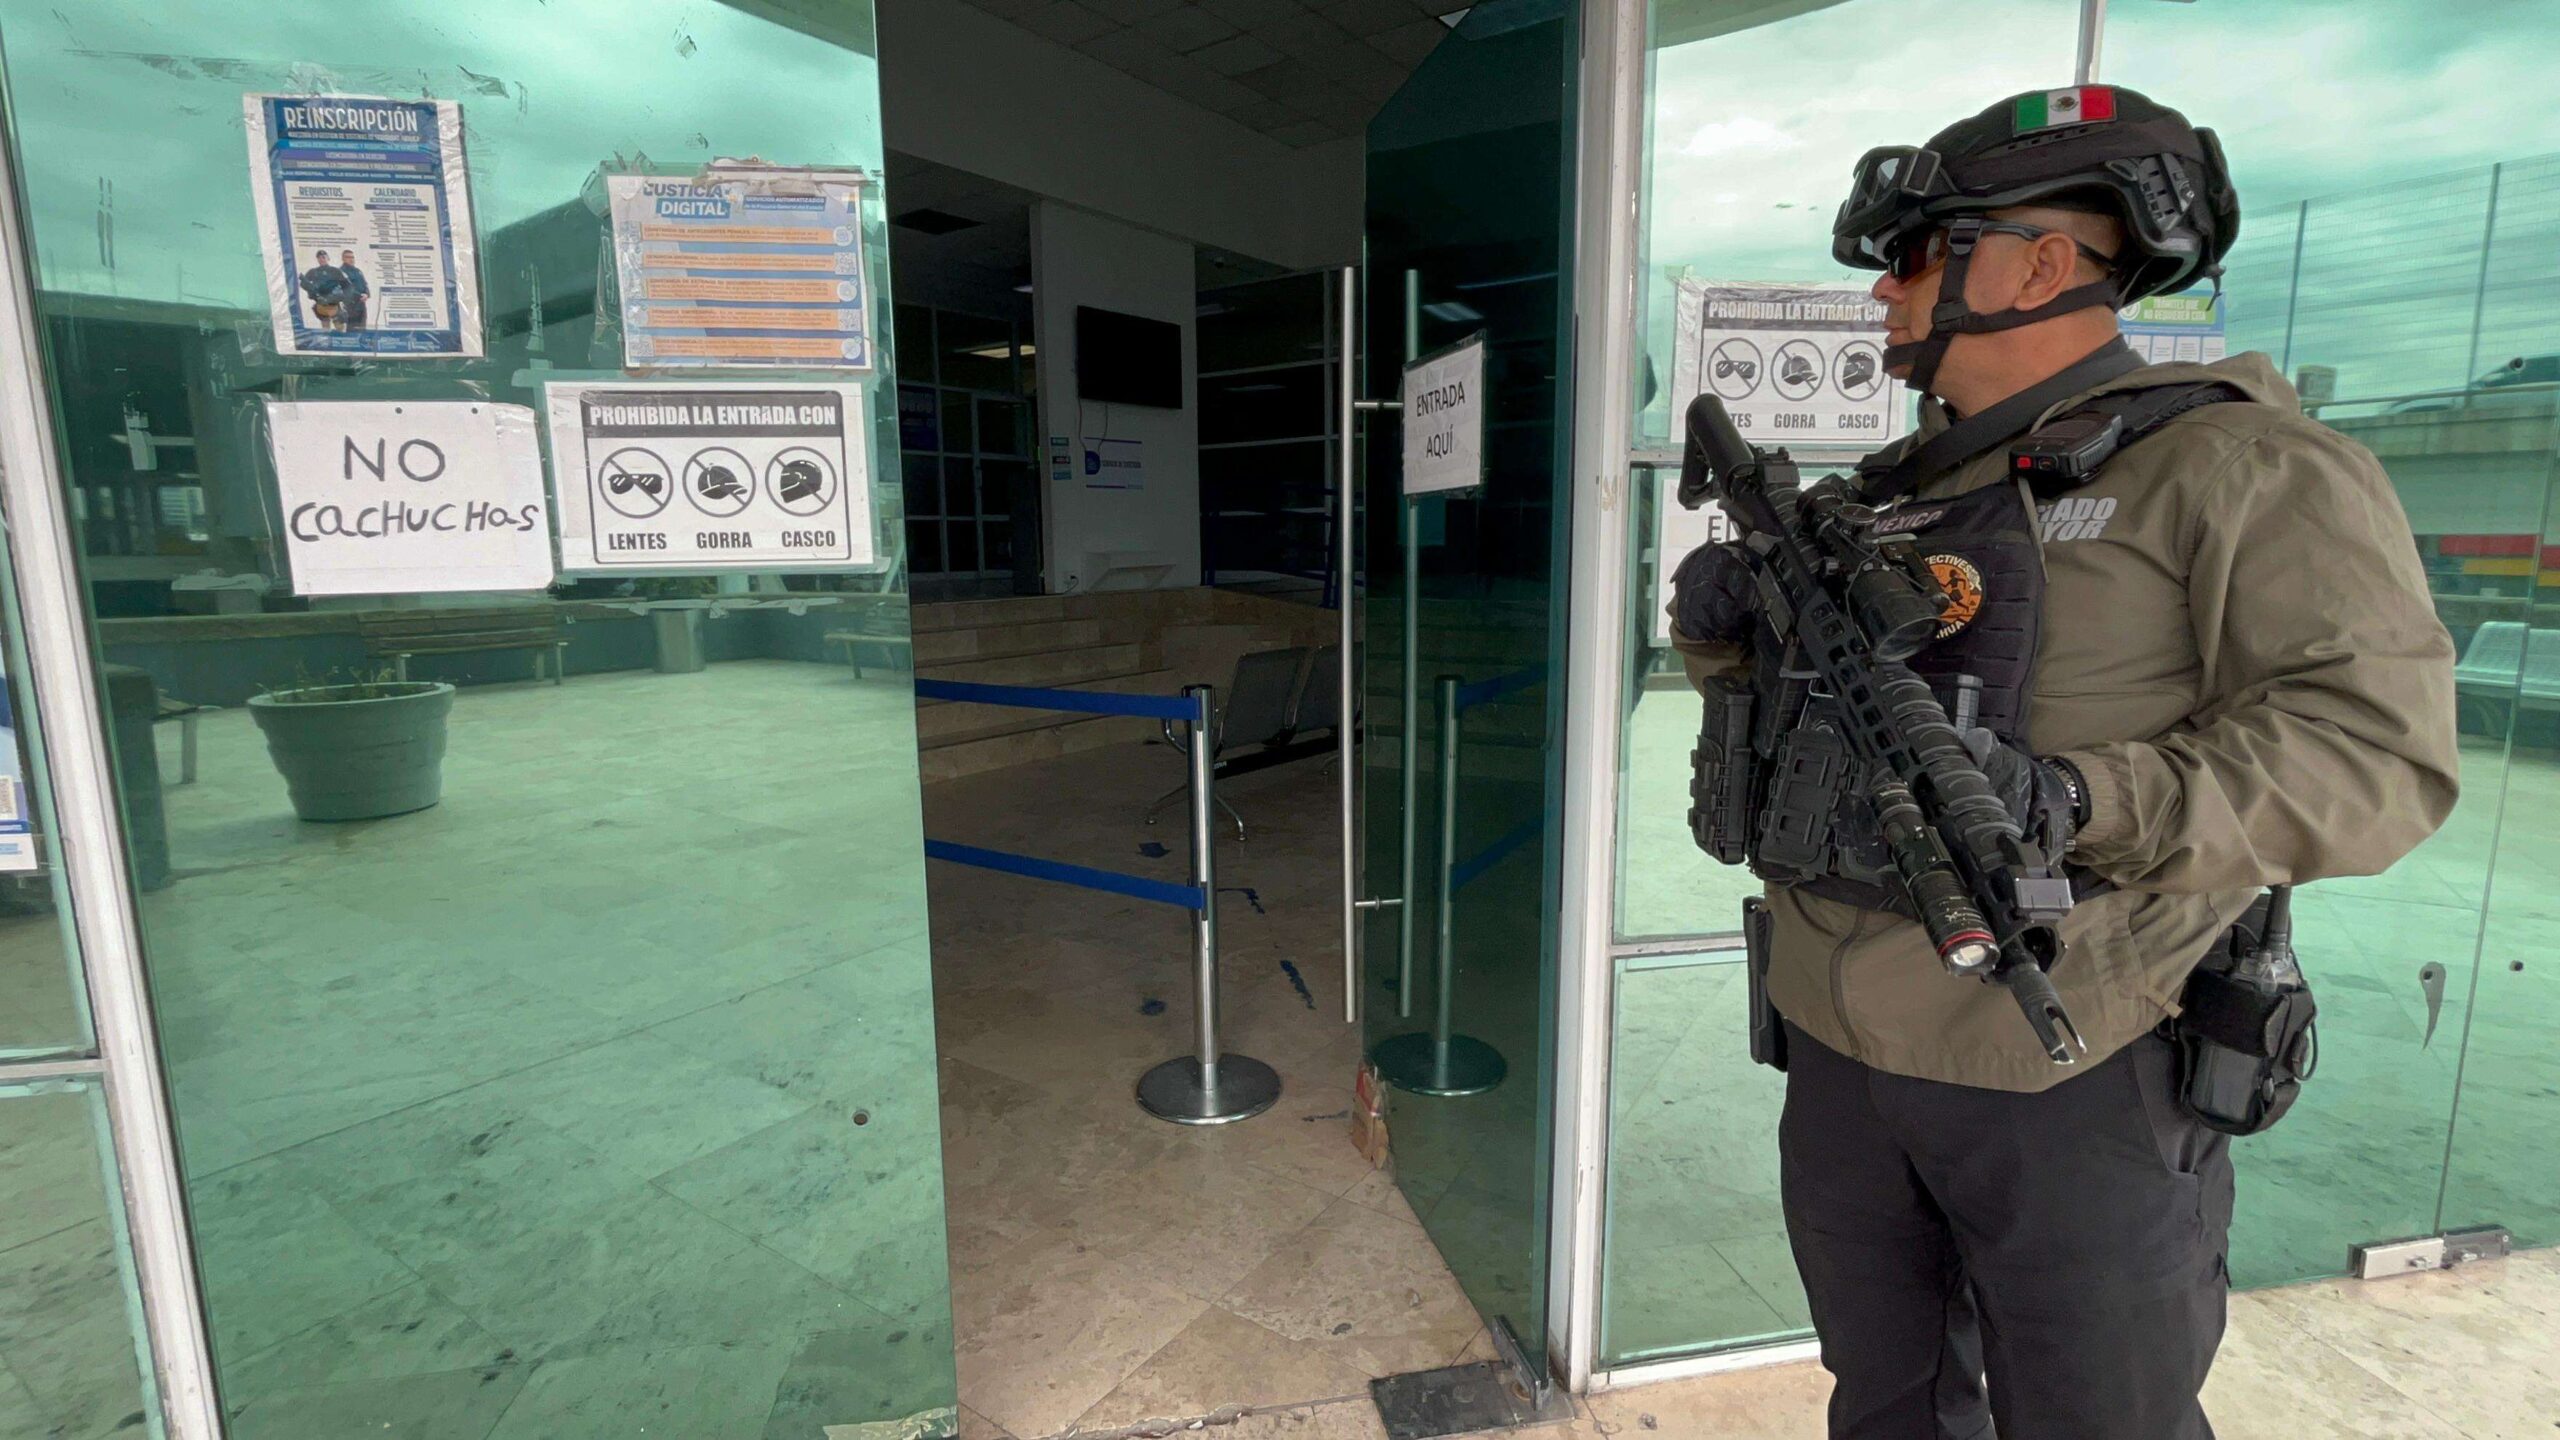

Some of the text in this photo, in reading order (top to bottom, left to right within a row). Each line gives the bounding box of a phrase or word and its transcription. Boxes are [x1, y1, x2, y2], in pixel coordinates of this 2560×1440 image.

[284, 106, 418, 132] REINSCRIPCIÓN
[299, 186, 416, 197] REQUISITOS CALENDARIO
[661, 201, 725, 215] DIGITAL
[1708, 302, 1783, 320] PROHIBIDA
[1786, 303, 1801, 320] LA
[1803, 304, 1862, 321] ENTRADA
[1416, 381, 1466, 417] ENTRADA
[590, 405, 836, 426] PROHIBIDA LA ENTRADA CON
[1774, 413, 1816, 429] GORRA
[1838, 413, 1879, 429] CASCO
[1426, 424, 1453, 459] AQUÍ
[344, 435, 446, 482] NO
[608, 533, 667, 551] LENTES
[696, 531, 752, 549] GORRA
[781, 531, 836, 548] CASCO
